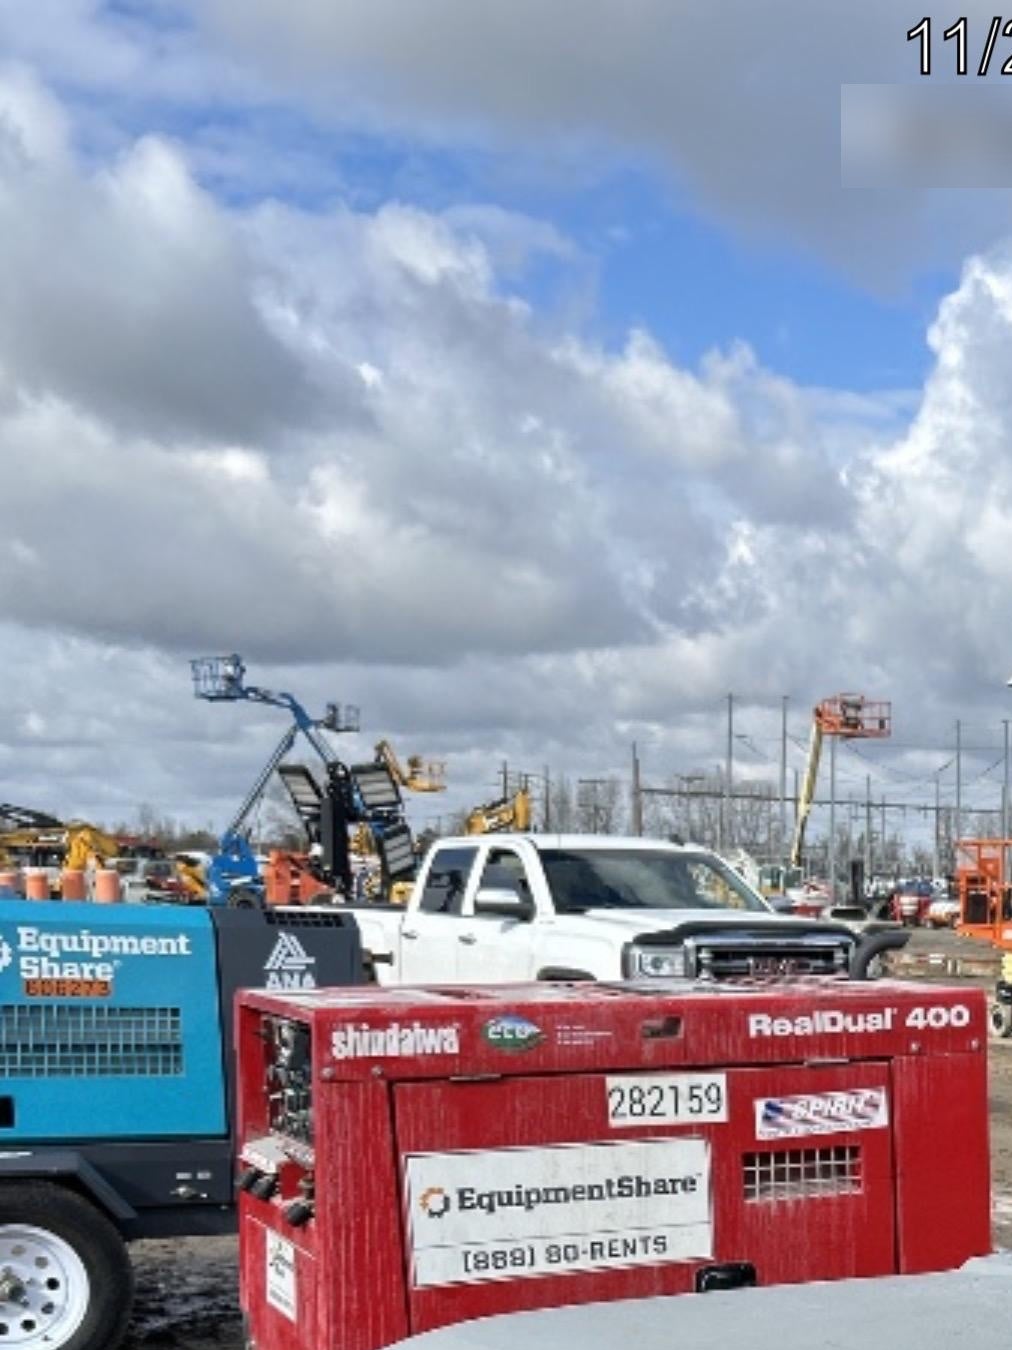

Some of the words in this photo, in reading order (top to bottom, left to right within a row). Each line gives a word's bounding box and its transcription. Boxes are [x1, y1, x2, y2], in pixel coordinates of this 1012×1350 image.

[17, 927, 192, 957] Equipment
[20, 956, 115, 979] Share
[748, 1012, 893, 1038] RealDual
[905, 1005, 971, 1031] 400
[332, 1022, 459, 1059] shindaiwa
[607, 1082, 723, 1118] 282159
[456, 1173, 698, 1214] EquipmentShare
[545, 1235, 668, 1266] 80-RENTS
